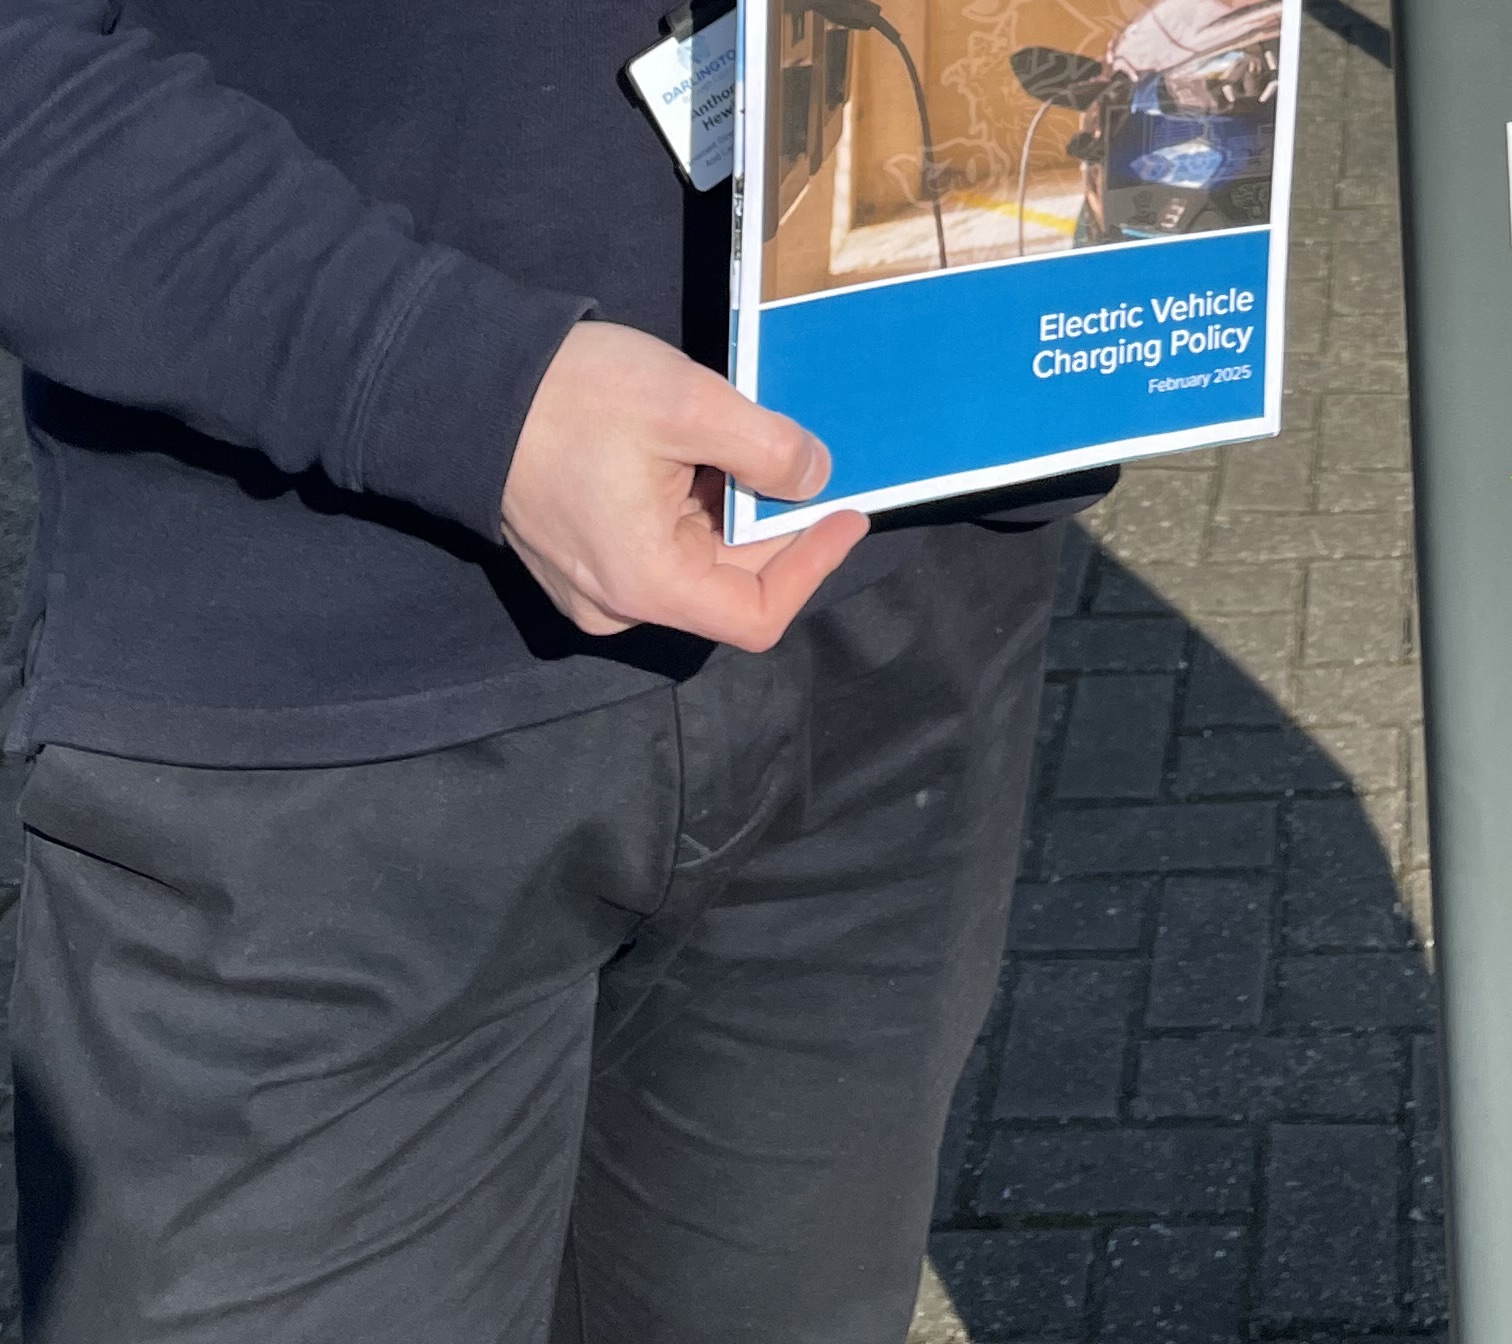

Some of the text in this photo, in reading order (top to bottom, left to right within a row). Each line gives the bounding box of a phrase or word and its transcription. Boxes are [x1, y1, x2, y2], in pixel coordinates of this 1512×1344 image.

[662, 47, 736, 105] DARLINGTO
[1039, 287, 1255, 342] Electric Vehicle
[1032, 323, 1254, 379] Charging Policy
[1147, 364, 1253, 394] February 2025
